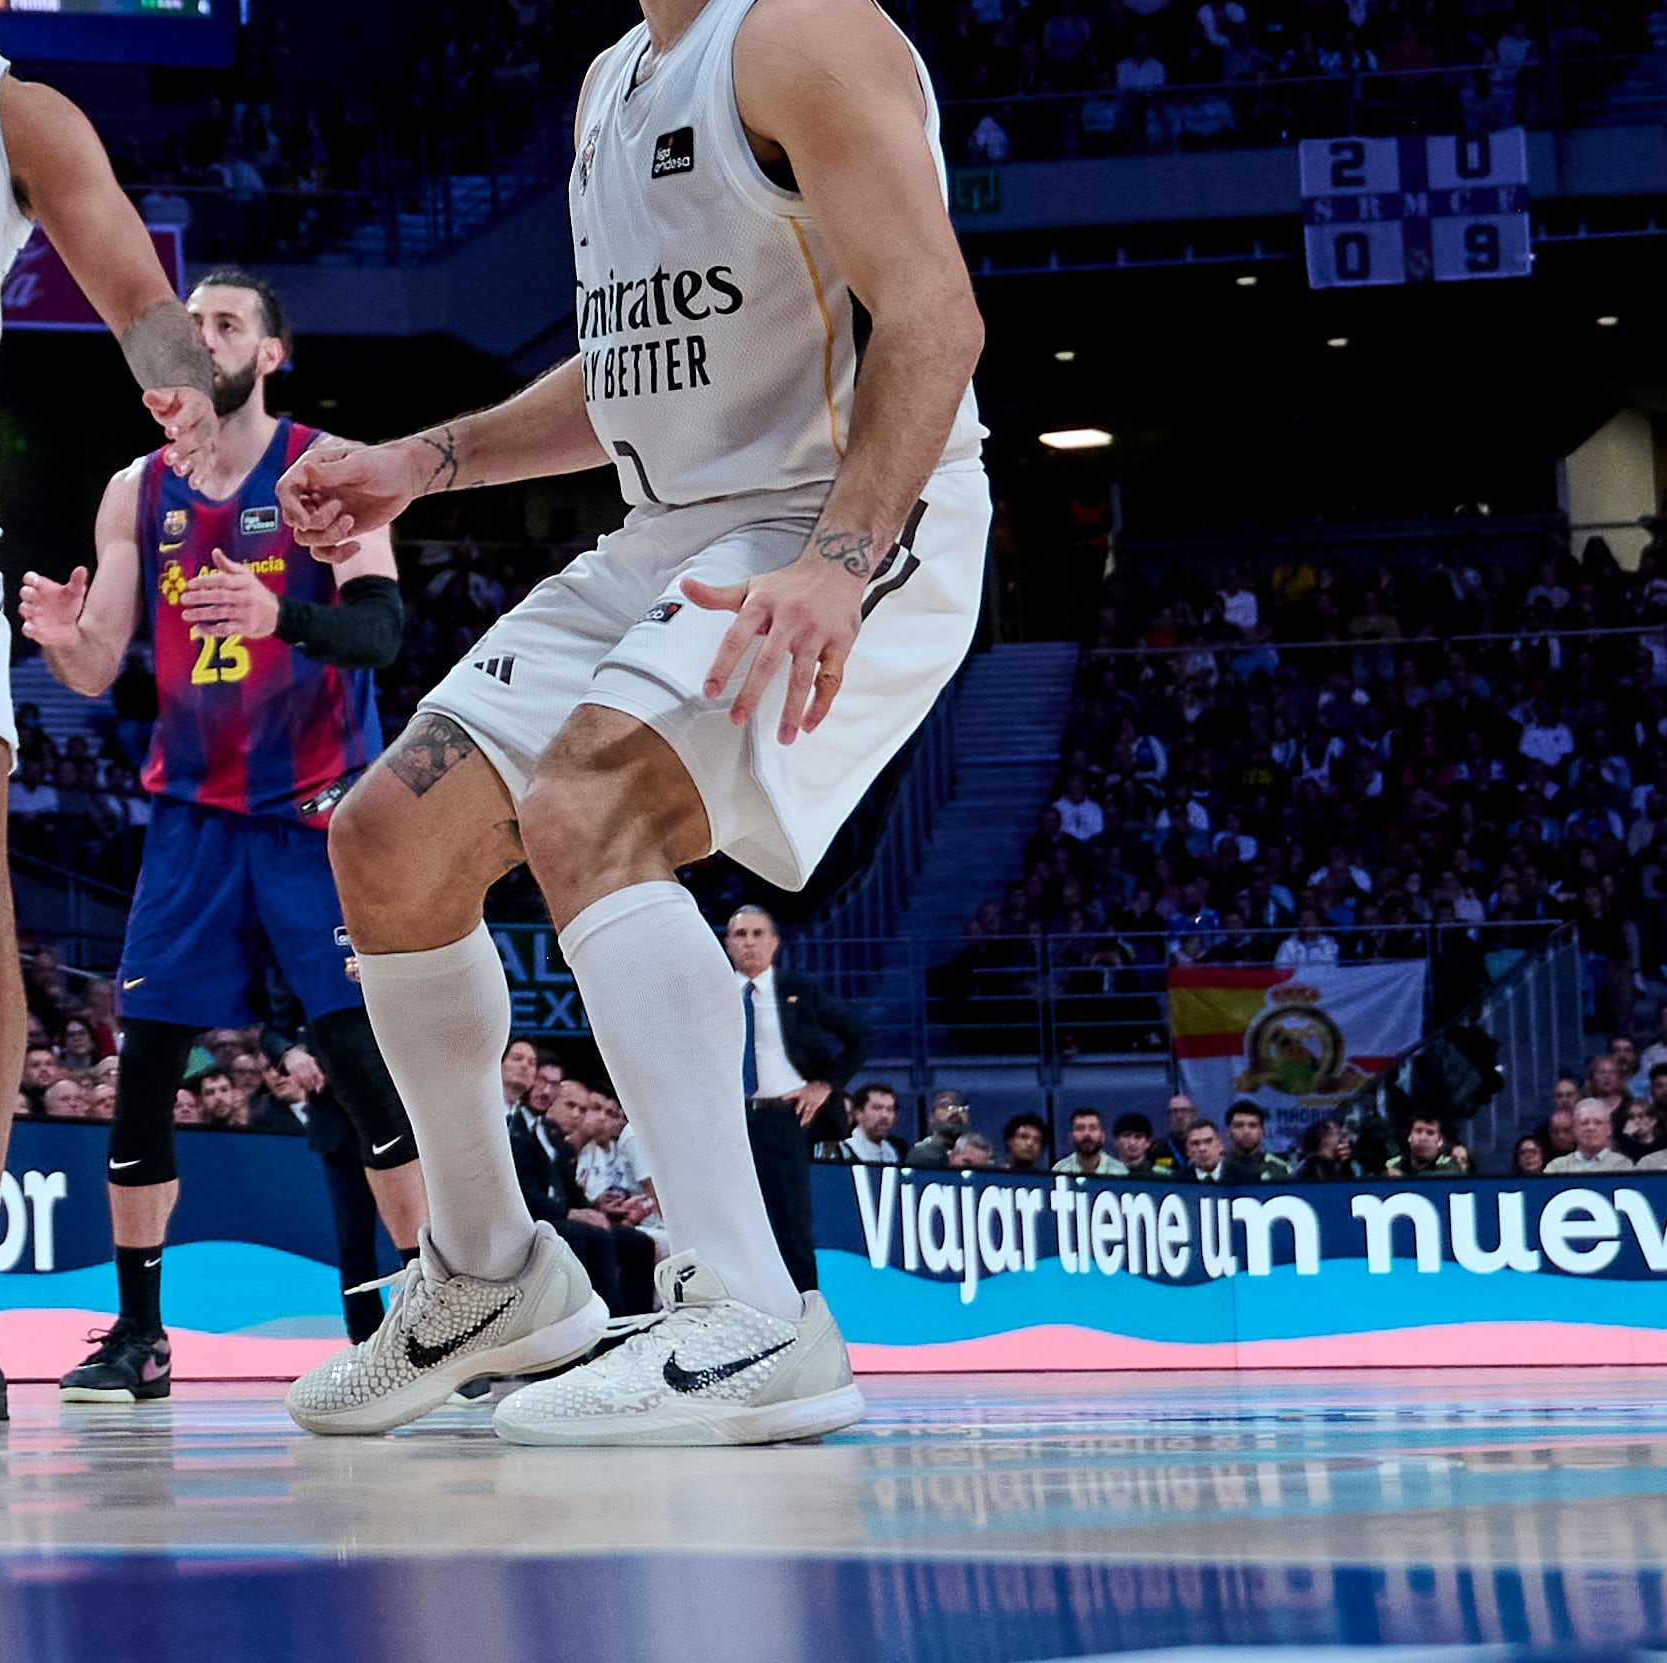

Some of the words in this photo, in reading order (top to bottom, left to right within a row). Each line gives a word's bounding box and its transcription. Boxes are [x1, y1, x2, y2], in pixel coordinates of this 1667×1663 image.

[653, 154, 690, 175] endesa
[1329, 141, 1365, 188] 2
[1456, 135, 1491, 180] 0
[1334, 232, 1370, 280] 0
[1464, 224, 1500, 273] 9
[604, 335, 711, 399] BETTER
[852, 1165, 1047, 1304] Viajar
[1050, 1176, 1191, 1277] tiene
[1199, 1191, 1319, 1277] un
